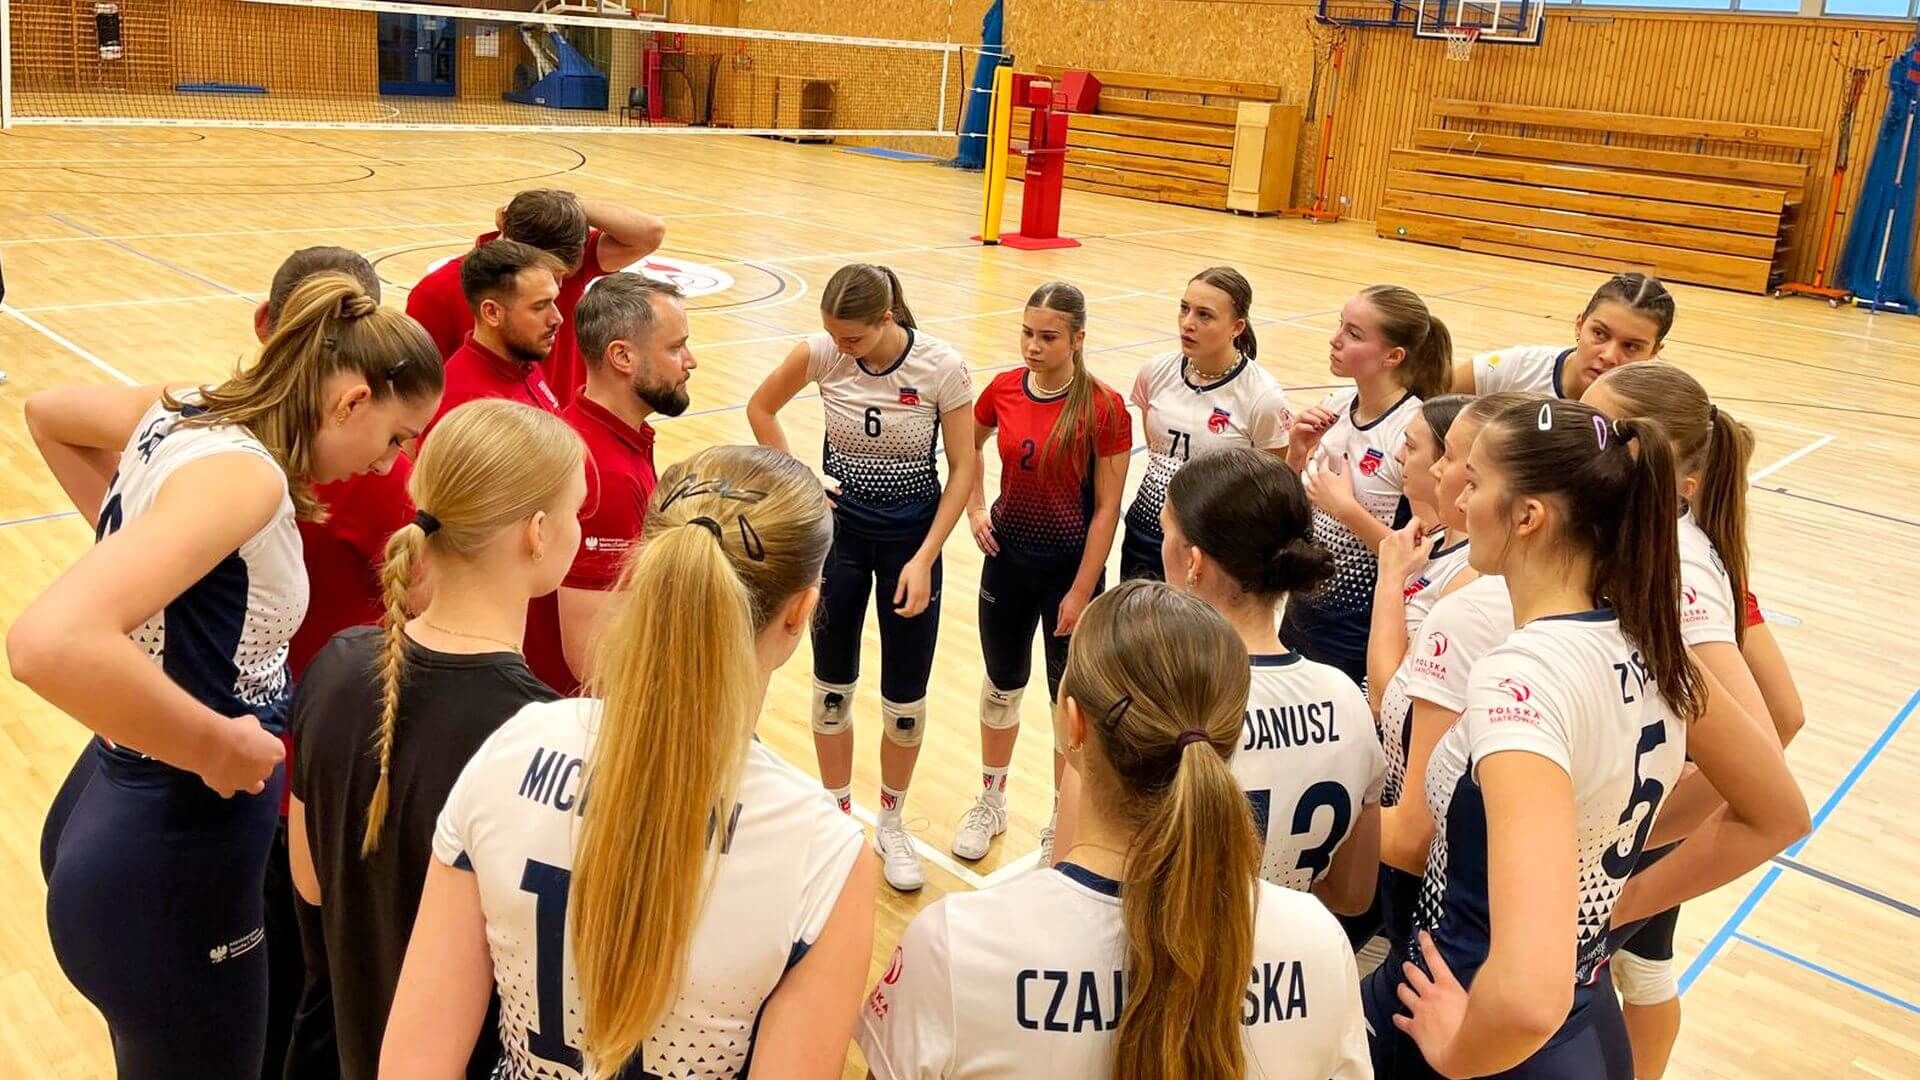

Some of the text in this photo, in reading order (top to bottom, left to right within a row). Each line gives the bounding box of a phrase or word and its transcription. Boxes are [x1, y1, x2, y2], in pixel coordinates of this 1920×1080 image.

[865, 407, 881, 438] 6
[1020, 439, 1036, 471] 2
[1168, 429, 1190, 461] 71
[1244, 701, 1340, 750] JANUSZ
[1488, 706, 1541, 720] POLSKA
[1601, 719, 1666, 879] 5
